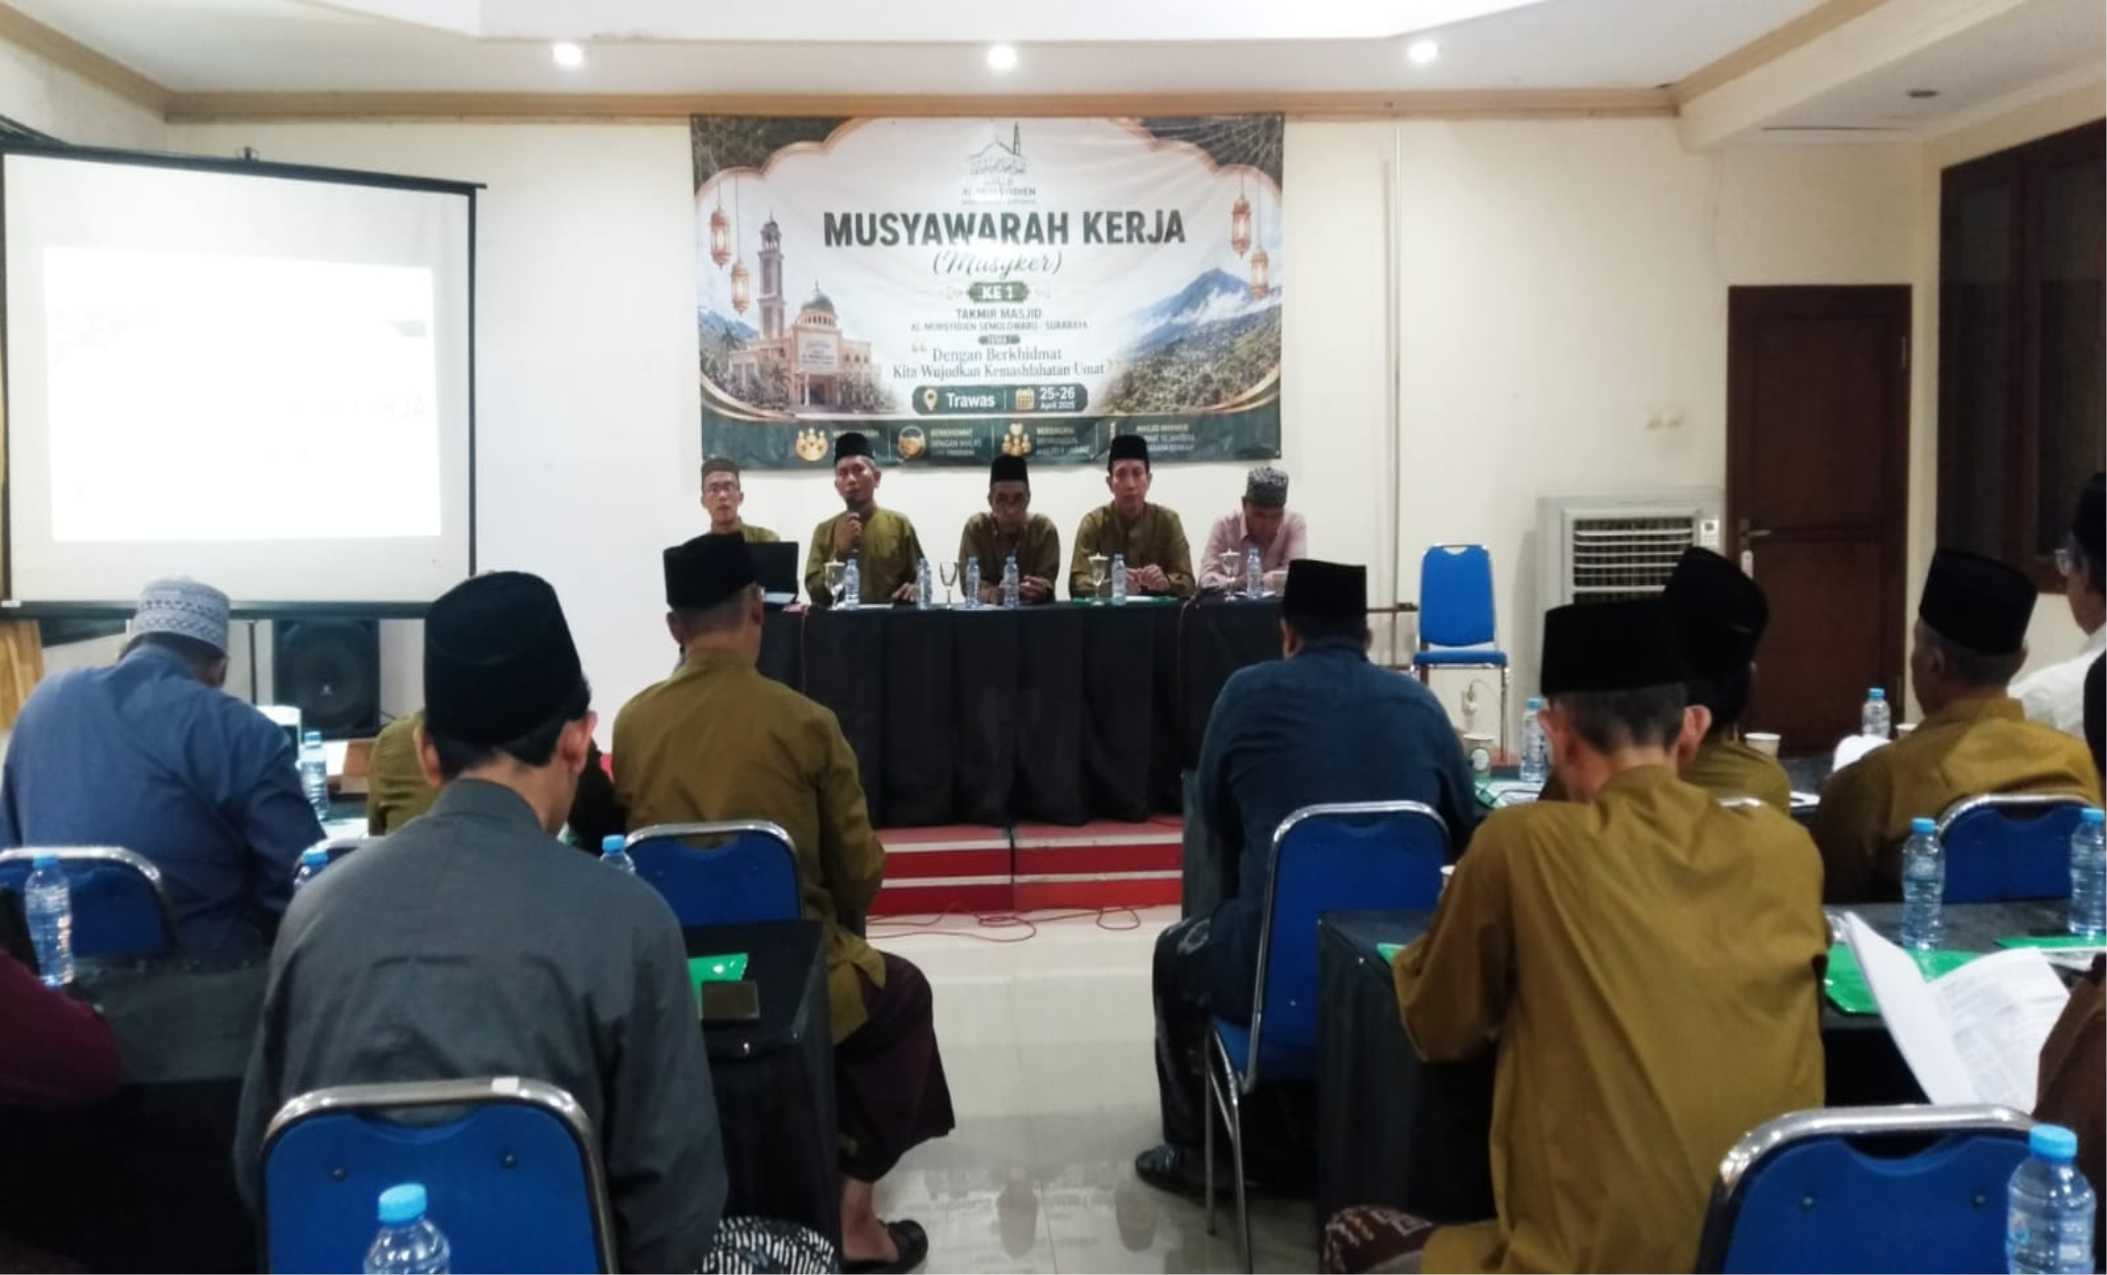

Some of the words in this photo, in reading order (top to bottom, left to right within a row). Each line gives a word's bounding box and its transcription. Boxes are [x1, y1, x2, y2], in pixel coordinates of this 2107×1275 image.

[823, 211, 1069, 247] MUSYAWARAH
[1083, 209, 1187, 245] KERJA
[932, 249, 1063, 281] (Musyker)
[981, 285, 1003, 300] KE
[1007, 285, 1014, 300] 1
[956, 308, 997, 320] TAKMIR
[1001, 307, 1043, 320] MASJID
[932, 348, 983, 365] Dengan
[986, 346, 1062, 361] Berkhidmat
[892, 365, 918, 378] Kita
[921, 363, 981, 381] Wujudkan
[1074, 361, 1105, 375] Umat
[946, 392, 996, 408] Trawas
[1040, 386, 1076, 400] 25-26
